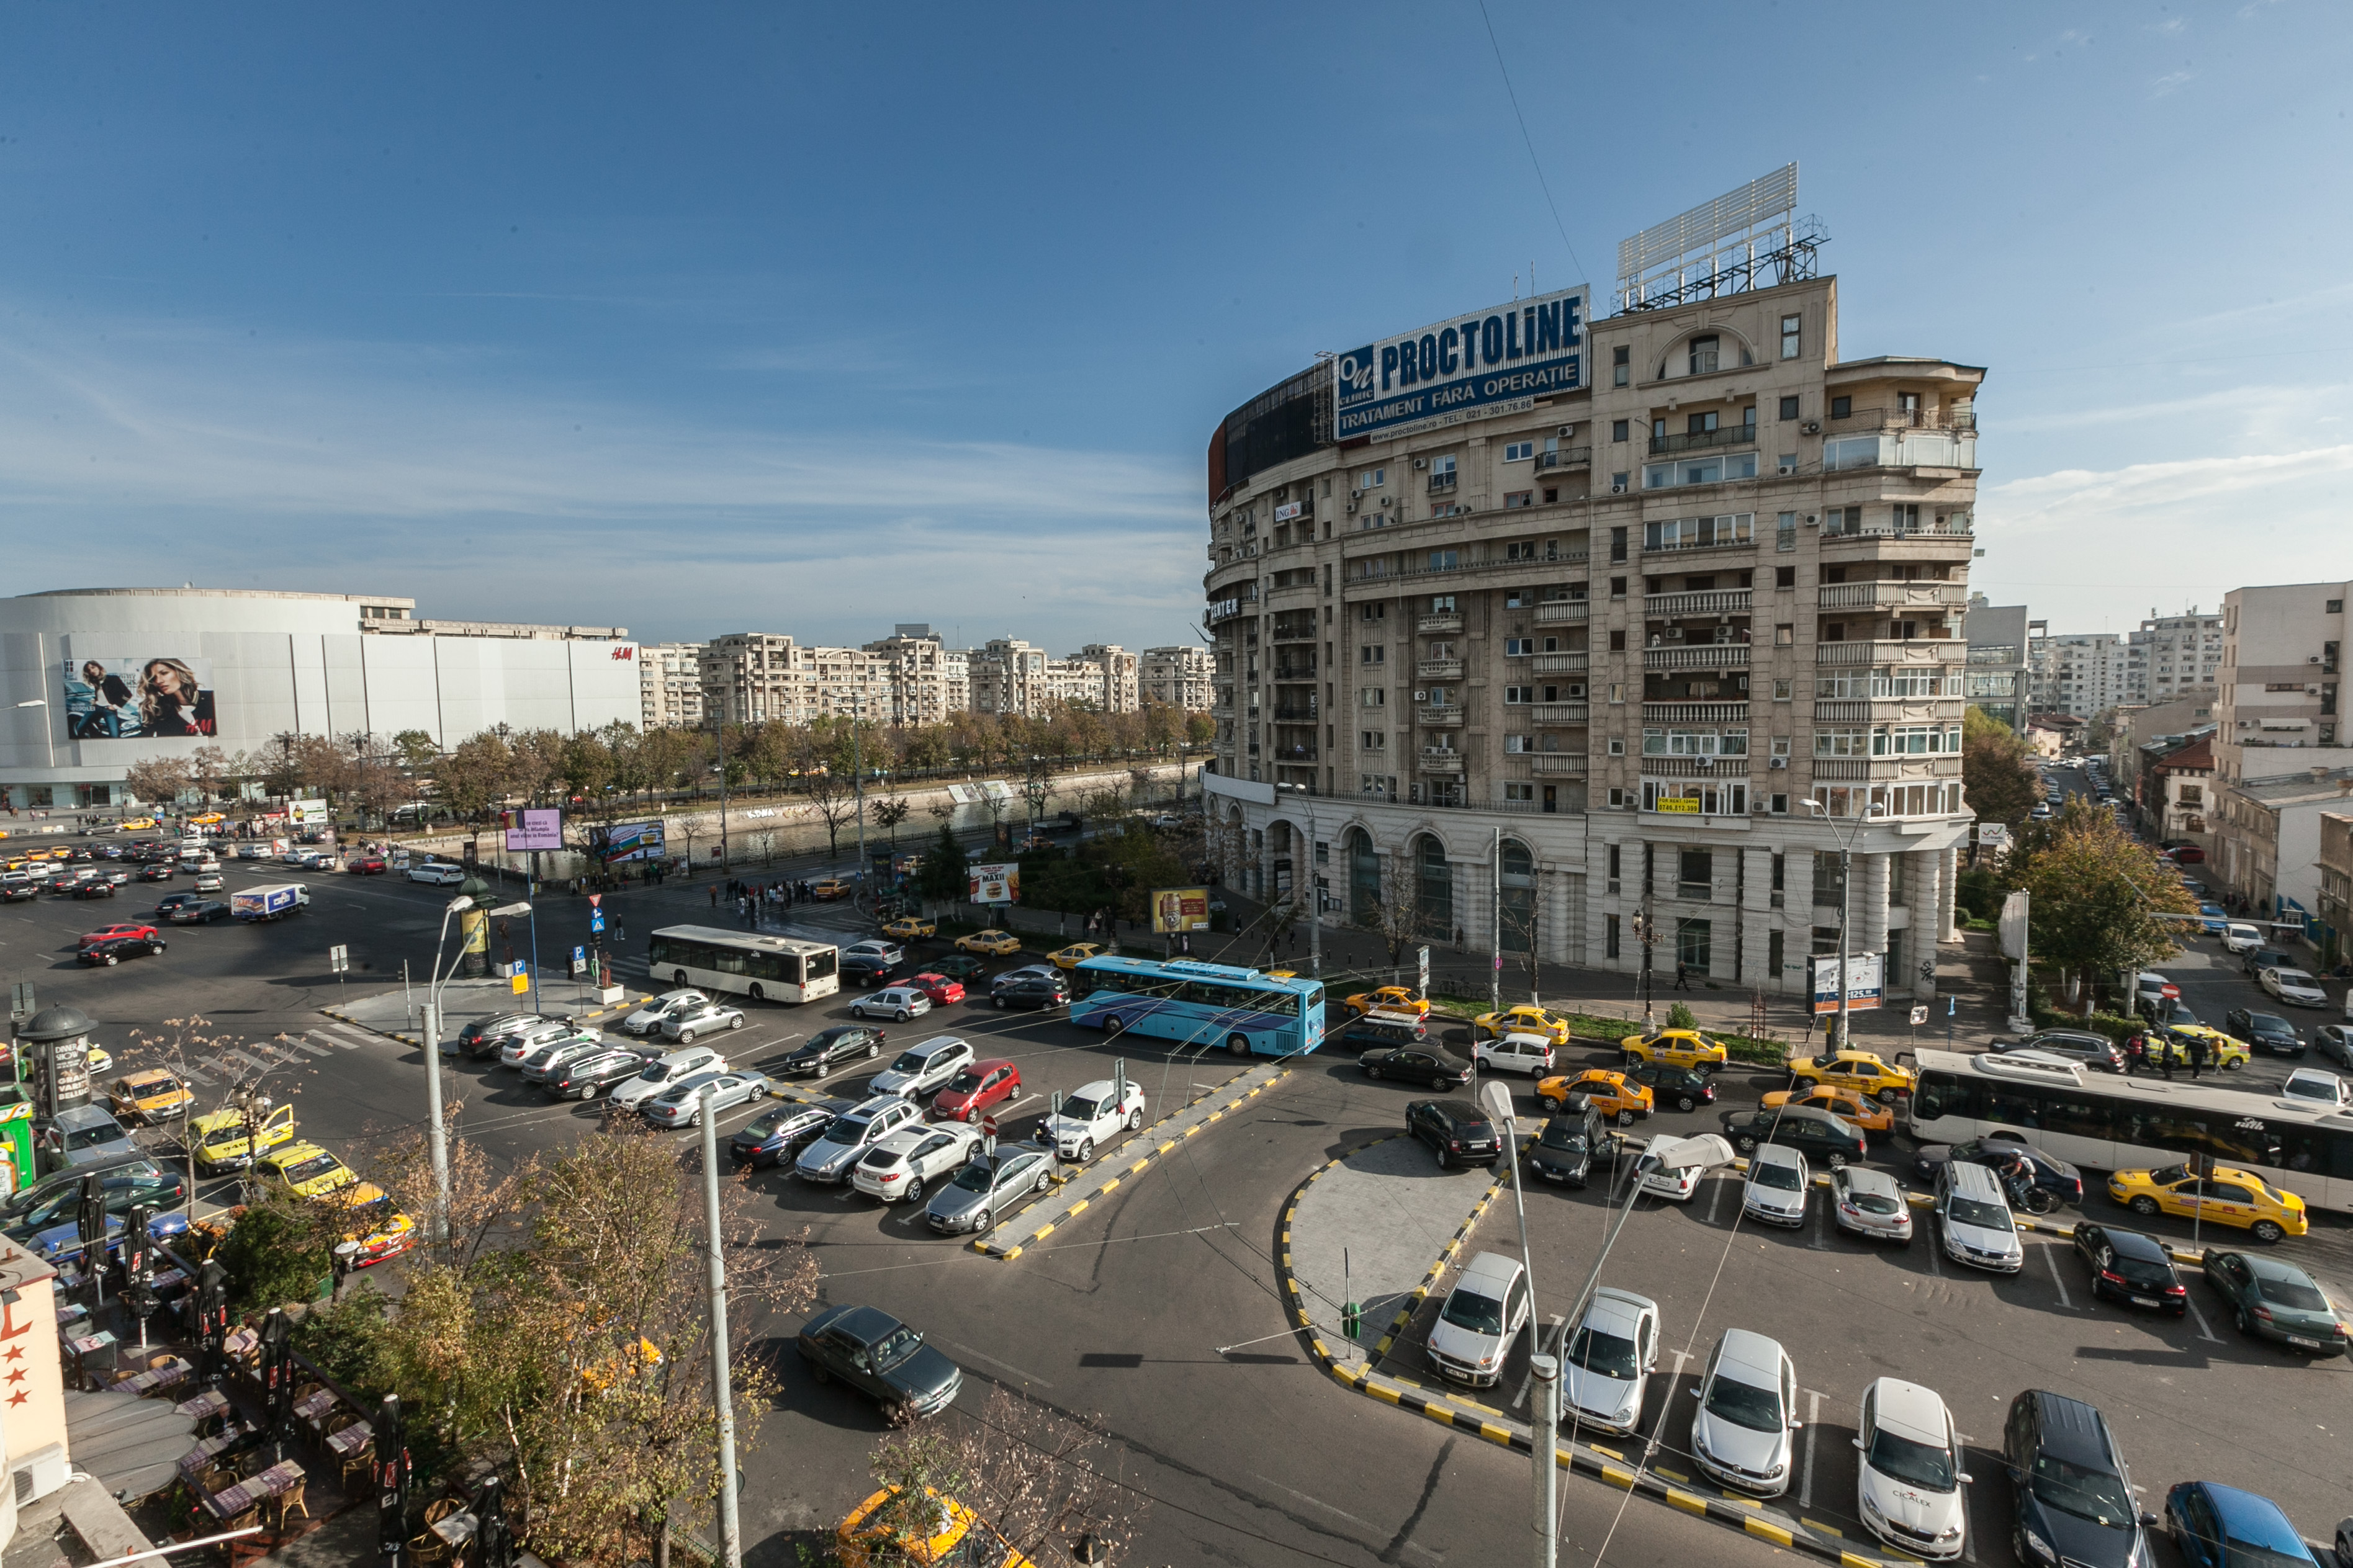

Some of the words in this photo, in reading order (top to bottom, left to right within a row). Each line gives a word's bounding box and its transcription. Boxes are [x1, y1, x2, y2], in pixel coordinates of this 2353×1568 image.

[1339, 390, 1373, 405] CLINIC
[1341, 396, 1424, 429] TRATAMENT
[1432, 380, 1476, 408] FĂRĂ
[1372, 421, 1437, 441] www.proctoline.ro
[1444, 414, 1462, 424] TEL:
[1466, 410, 1481, 419] 021
[1490, 400, 1532, 414] 301.76.86
[1277, 508, 1289, 519] ING
[611, 647, 633, 661] H&M
[186, 719, 213, 733] H&M
[576, 946, 582, 959] P
[515, 961, 523, 973] P
[55, 1043, 77, 1054] DINNER
[56, 1051, 79, 1060] SHOW
